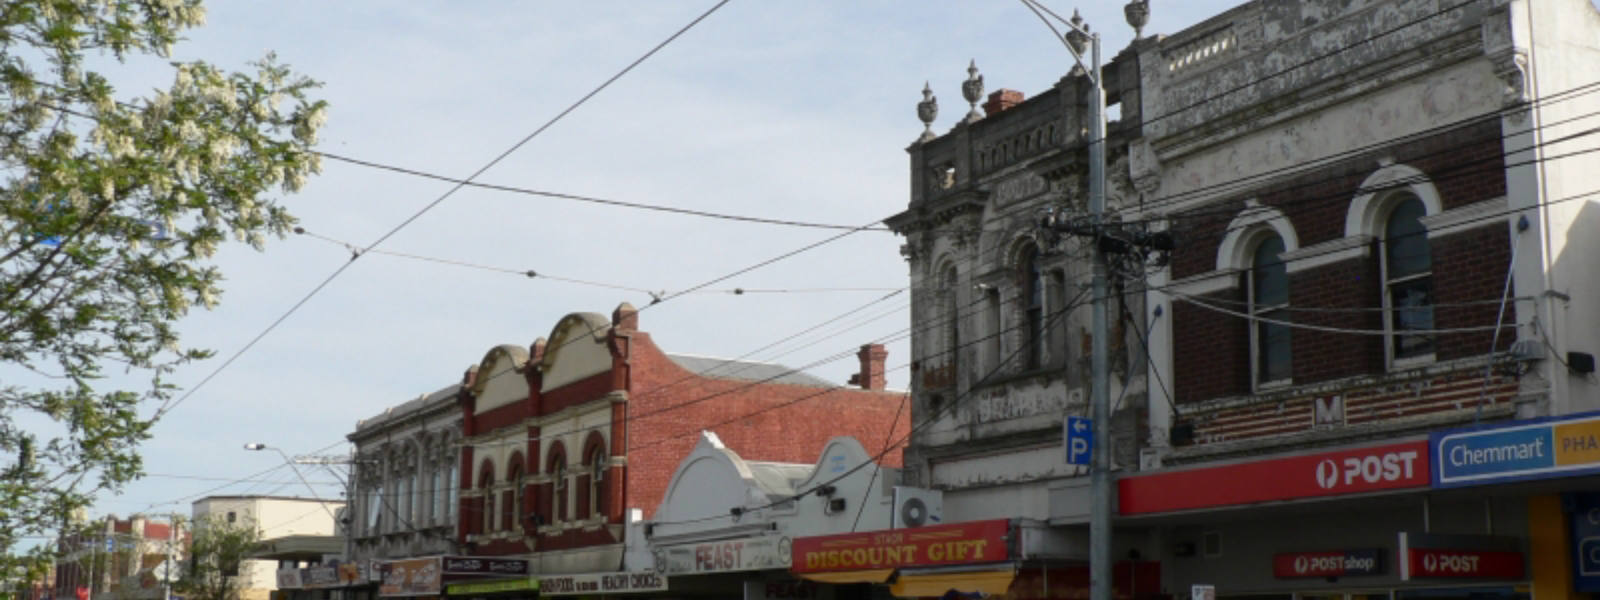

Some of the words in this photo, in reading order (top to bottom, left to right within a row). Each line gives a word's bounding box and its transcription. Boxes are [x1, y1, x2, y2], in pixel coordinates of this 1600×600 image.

[1072, 438, 1088, 464] P
[1450, 436, 1545, 467] Chemmart
[1344, 451, 1417, 485] POST
[696, 543, 744, 570] FEAST
[806, 545, 917, 569] DISCOUNT
[927, 540, 987, 561] GIFT
[1439, 555, 1480, 572] POST
